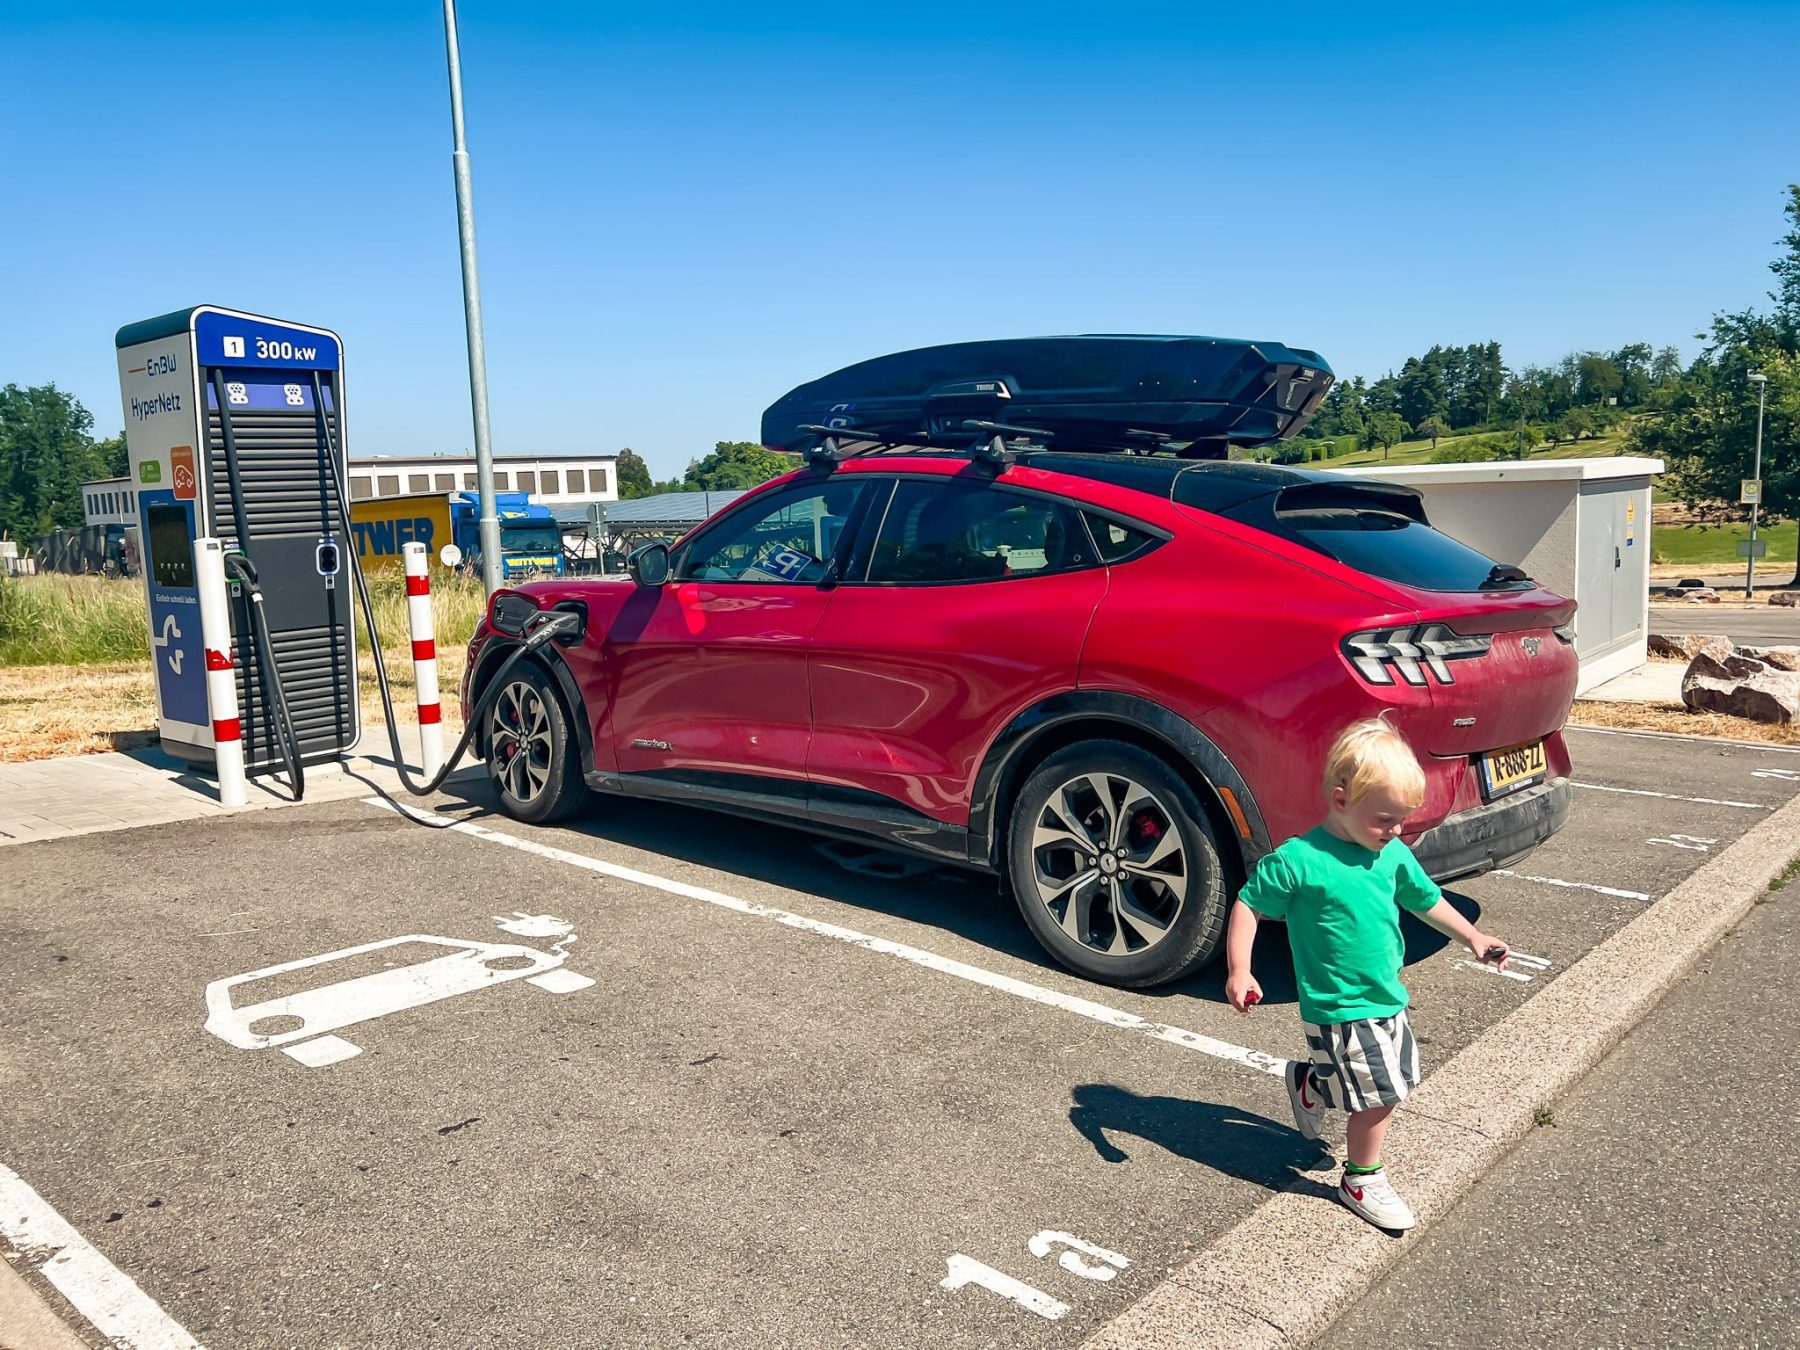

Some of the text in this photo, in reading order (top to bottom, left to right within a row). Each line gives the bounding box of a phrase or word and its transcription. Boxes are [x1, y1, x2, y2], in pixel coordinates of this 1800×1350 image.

[147, 353, 177, 377] EnBW
[131, 392, 181, 421] HyperNetz
[1493, 742, 1543, 782] R-888-ZZ
[938, 1229, 1137, 1320] 1a
